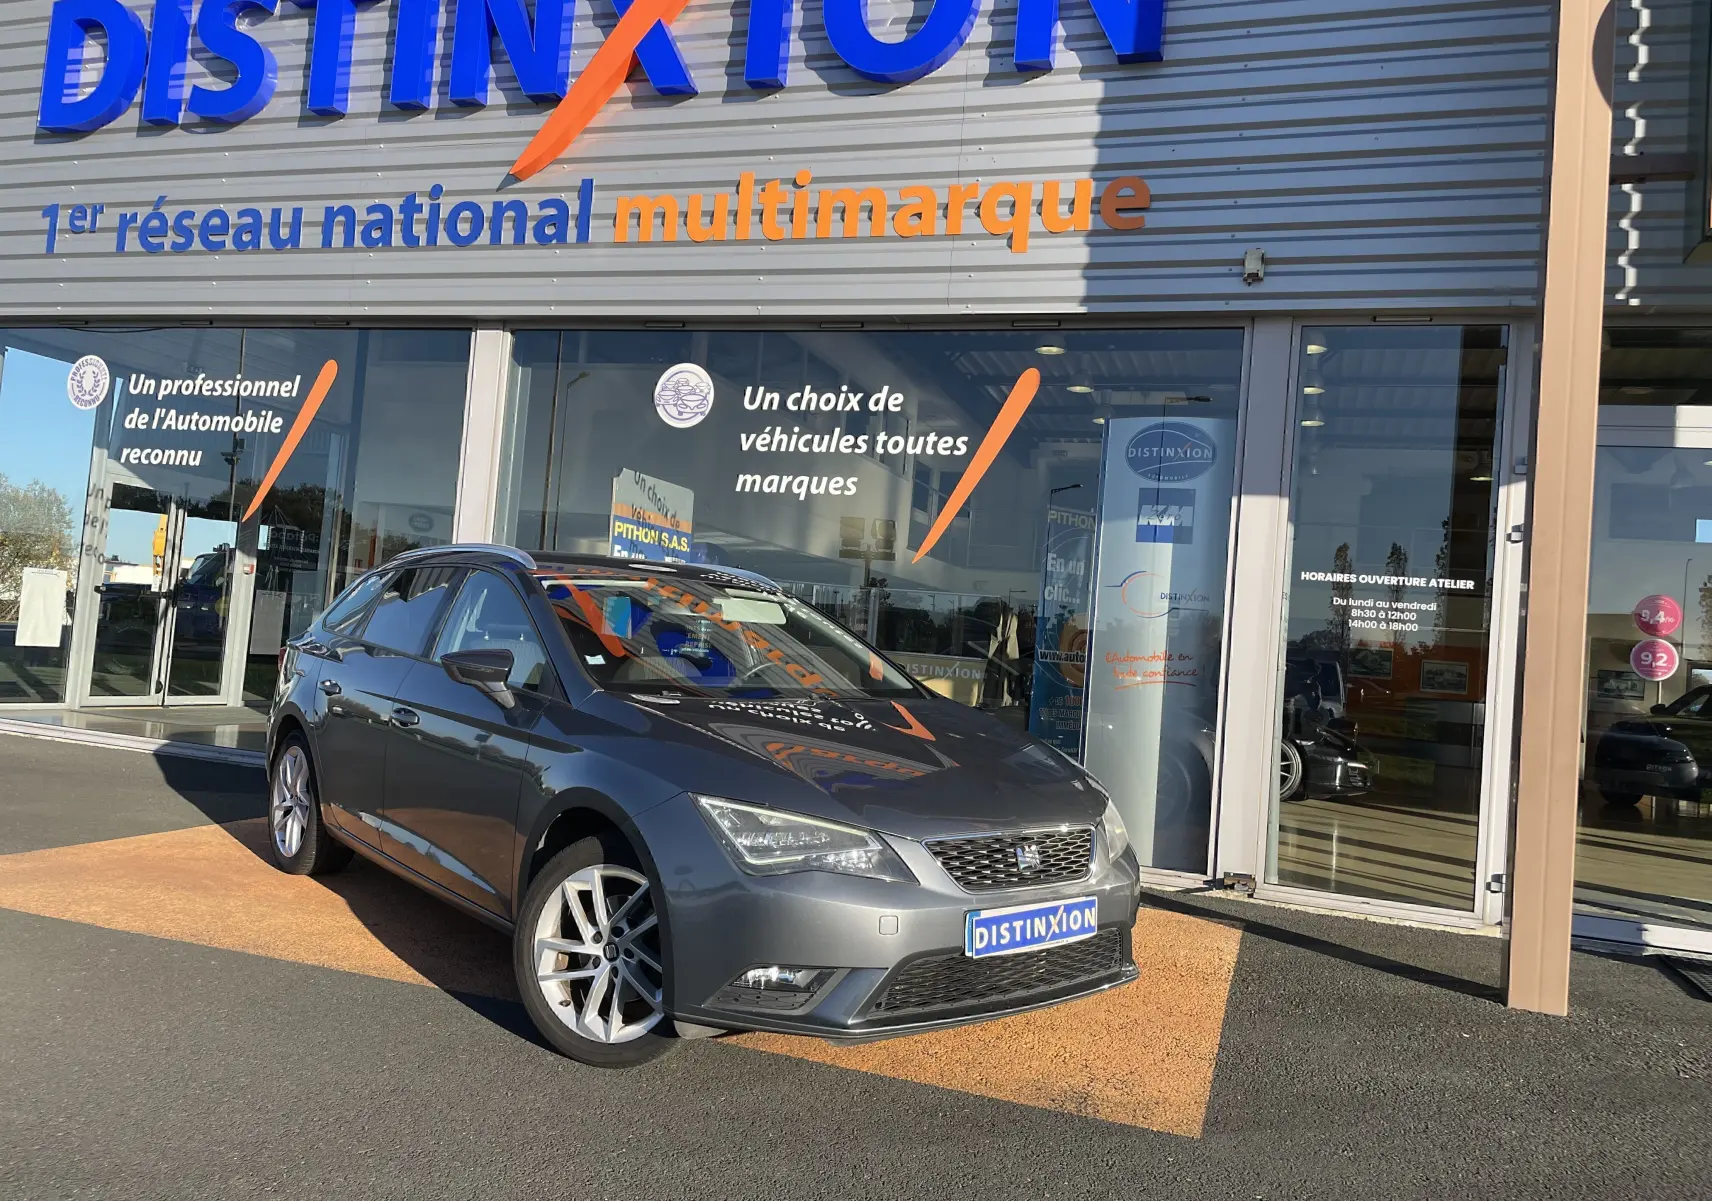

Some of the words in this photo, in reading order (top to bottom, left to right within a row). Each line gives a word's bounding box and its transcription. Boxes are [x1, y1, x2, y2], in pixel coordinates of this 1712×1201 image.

[40, 201, 105, 254] 1er
[116, 195, 303, 254] réseau
[320, 178, 595, 249] national
[614, 169, 1152, 253] multimarque
[129, 374, 154, 395] Un
[158, 373, 301, 400] professionnel
[744, 386, 779, 411] Un
[787, 385, 863, 411] choix
[869, 386, 904, 412] de
[124, 408, 147, 430] de
[152, 408, 283, 433] l'Automobile
[740, 427, 868, 454] véhicules
[876, 431, 968, 455] toutes
[1128, 442, 1213, 460] DISTINXION
[120, 446, 202, 467] reconnu
[736, 472, 858, 500] marques
[1048, 510, 1096, 532] PITHON
[615, 520, 658, 544] PITHON
[661, 532, 690, 552] S.A.S.
[1047, 552, 1064, 573] En
[1301, 572, 1357, 583] HORAIRES
[1359, 574, 1427, 587] OUVERTURE
[1428, 578, 1475, 590] ATELIER
[1333, 597, 1346, 606] Du
[1349, 598, 1374, 608] lundi
[1391, 601, 1437, 611] vendredi
[1351, 608, 1376, 618] 8h30
[1378, 610, 1385, 619] à
[1388, 611, 1417, 621] 12h00
[1348, 619, 1377, 629] 14h00
[1379, 620, 1386, 630] à
[1389, 621, 1419, 632] 18h00
[1178, 653, 1193, 661] en
[1640, 651, 1668, 668] 9,2
[900, 661, 981, 680] ISTINXION
[975, 905, 1096, 949] DISTINXION
